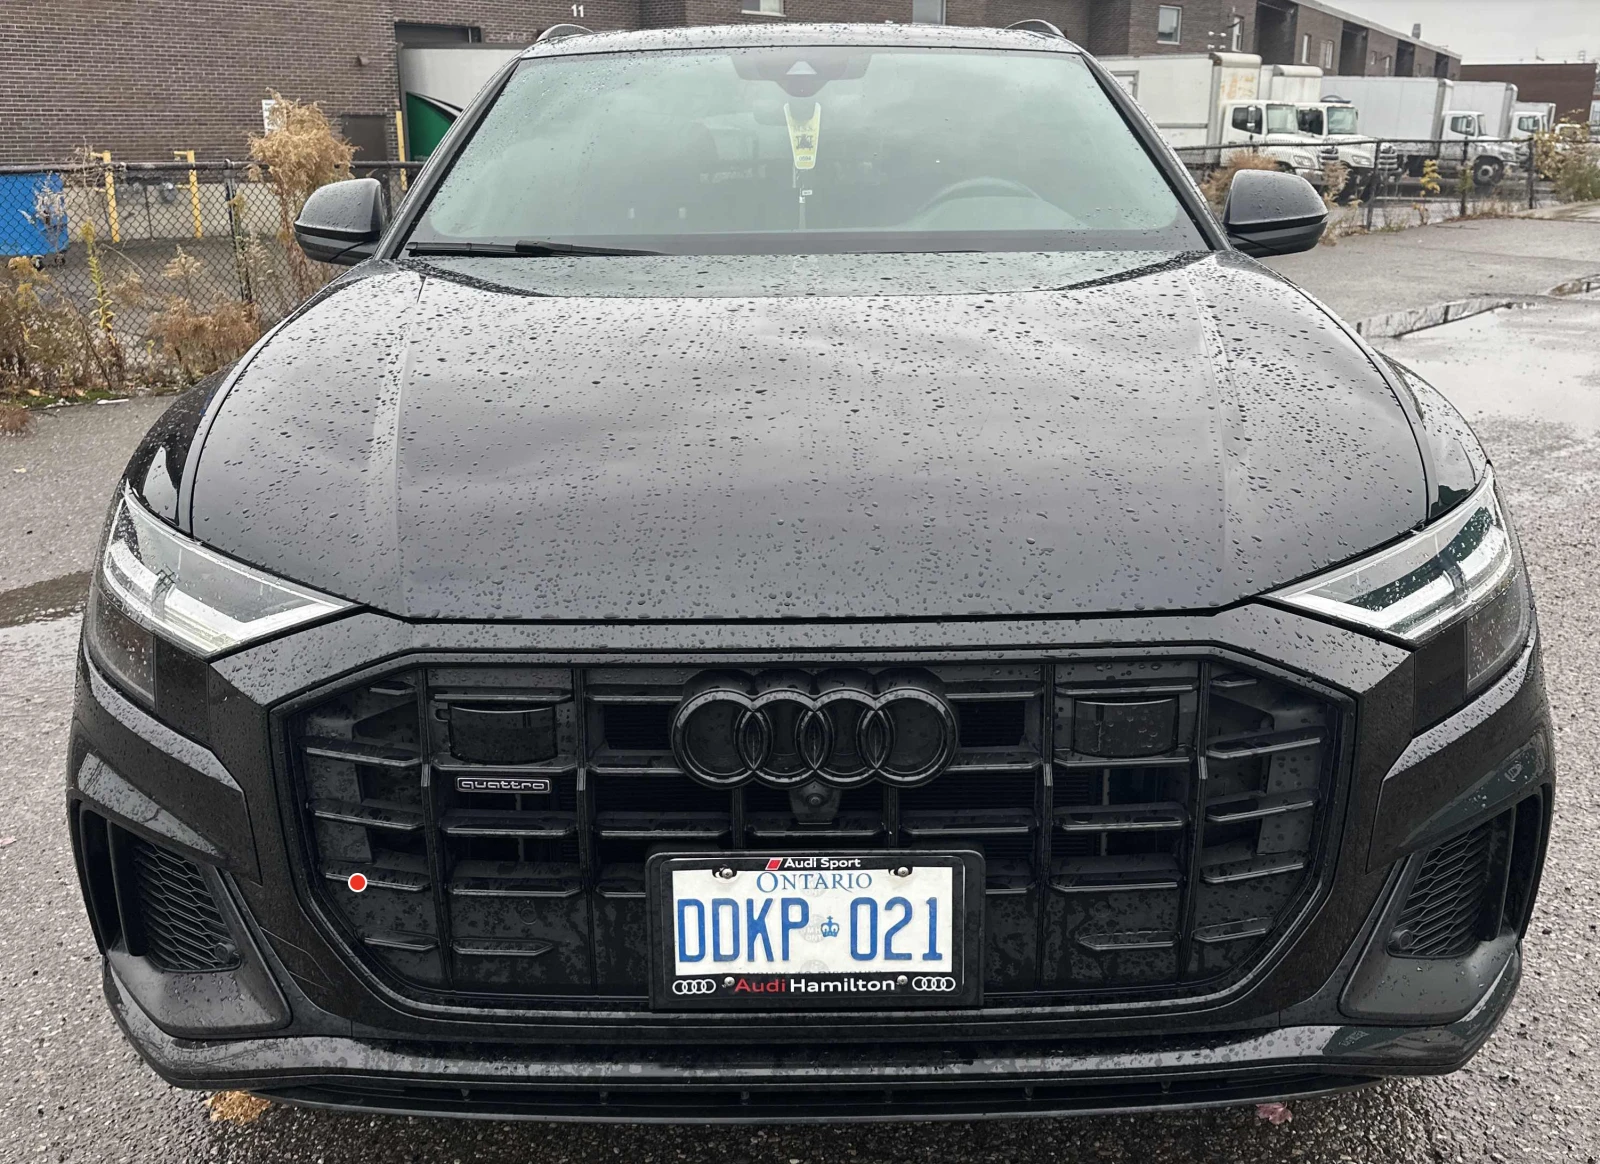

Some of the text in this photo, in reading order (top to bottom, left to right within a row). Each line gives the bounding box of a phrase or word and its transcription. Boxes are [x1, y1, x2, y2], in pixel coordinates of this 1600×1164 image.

[571, 4, 584, 17] 11
[461, 781, 545, 789] quattro
[784, 858, 861, 870] Audi Sport
[756, 871, 872, 893] ONTARIO
[677, 896, 943, 963] DDKP 021
[734, 977, 896, 993] Audi Hamilton
